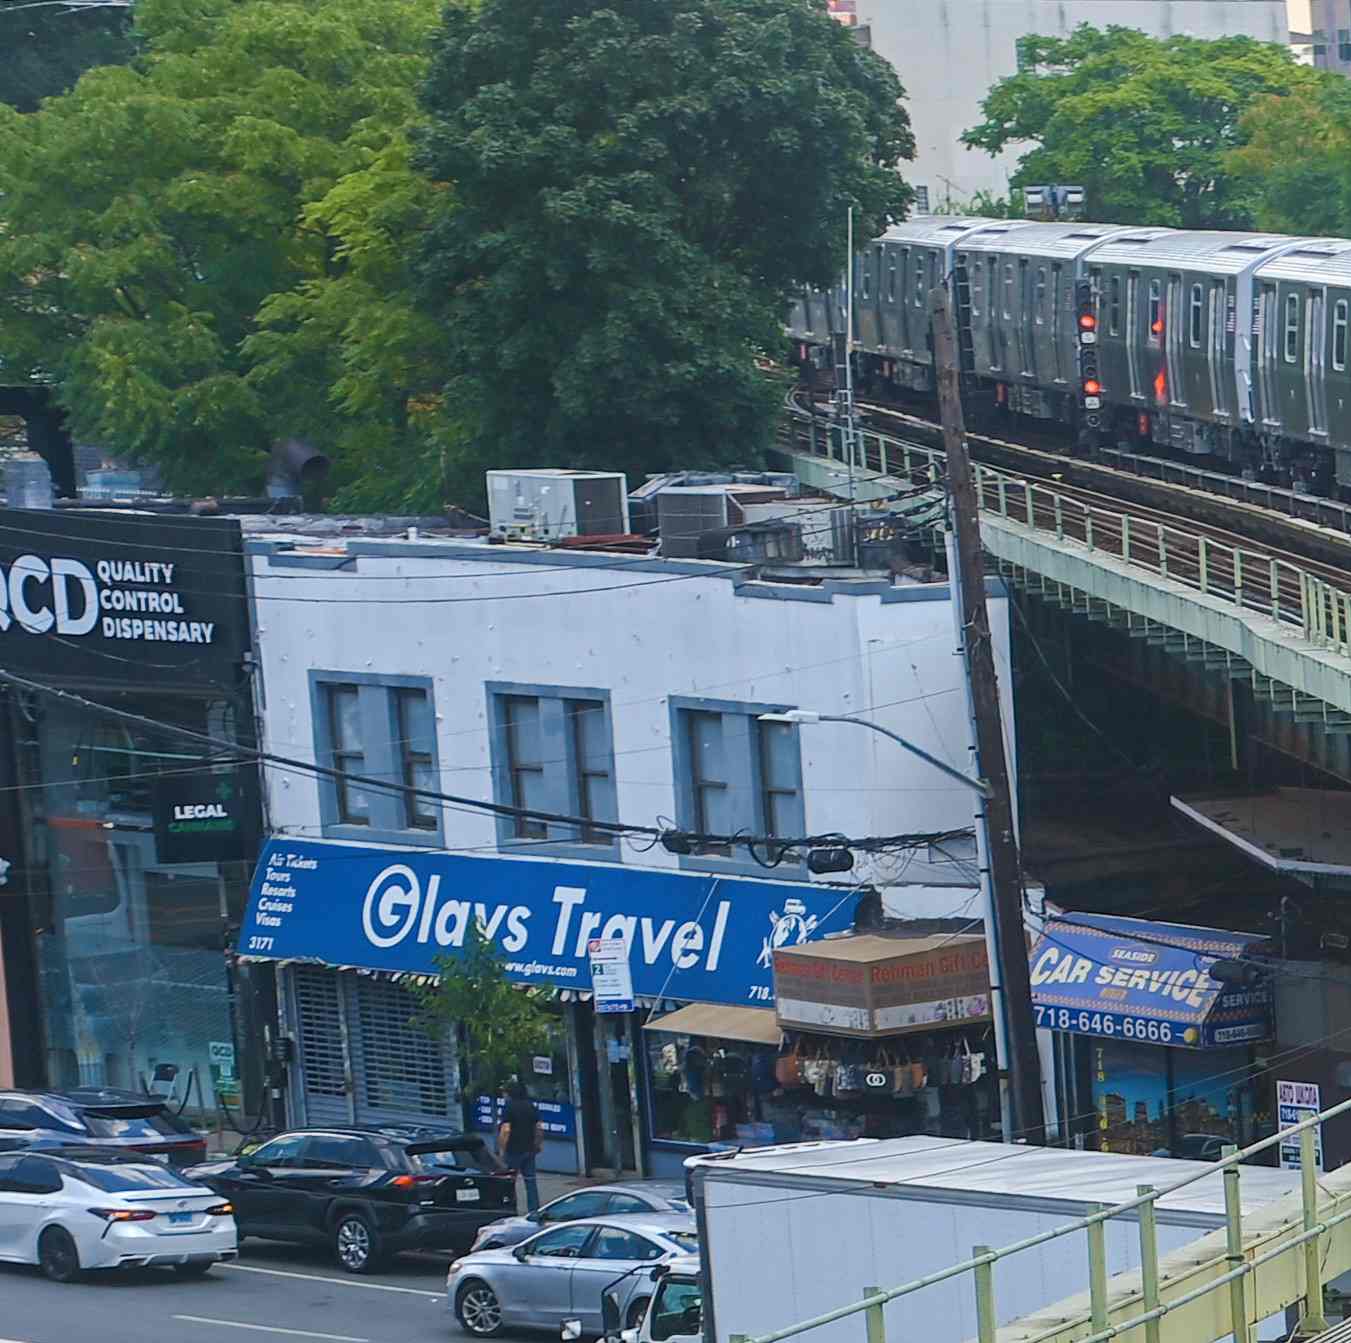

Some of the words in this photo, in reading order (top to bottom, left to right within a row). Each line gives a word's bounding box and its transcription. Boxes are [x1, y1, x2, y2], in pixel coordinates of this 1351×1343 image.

[0, 554, 98, 636] CD
[100, 589, 184, 614] CONTROL
[102, 617, 214, 644] DISPENSARY
[174, 804, 228, 820] LEGAL
[268, 852, 285, 867] Air
[286, 854, 318, 870] Tickets
[265, 867, 291, 882] Tours
[260, 882, 296, 898] Resorts
[258, 897, 293, 913] Cruises
[255, 911, 281, 927] Visas
[363, 864, 533, 953] Glavs
[552, 886, 730, 972] Travel
[248, 936, 274, 951] 3171
[1030, 948, 1093, 986] CAR
[1094, 965, 1213, 1008] SERVICE
[1033, 1006, 1172, 1043] 718-646-6666
